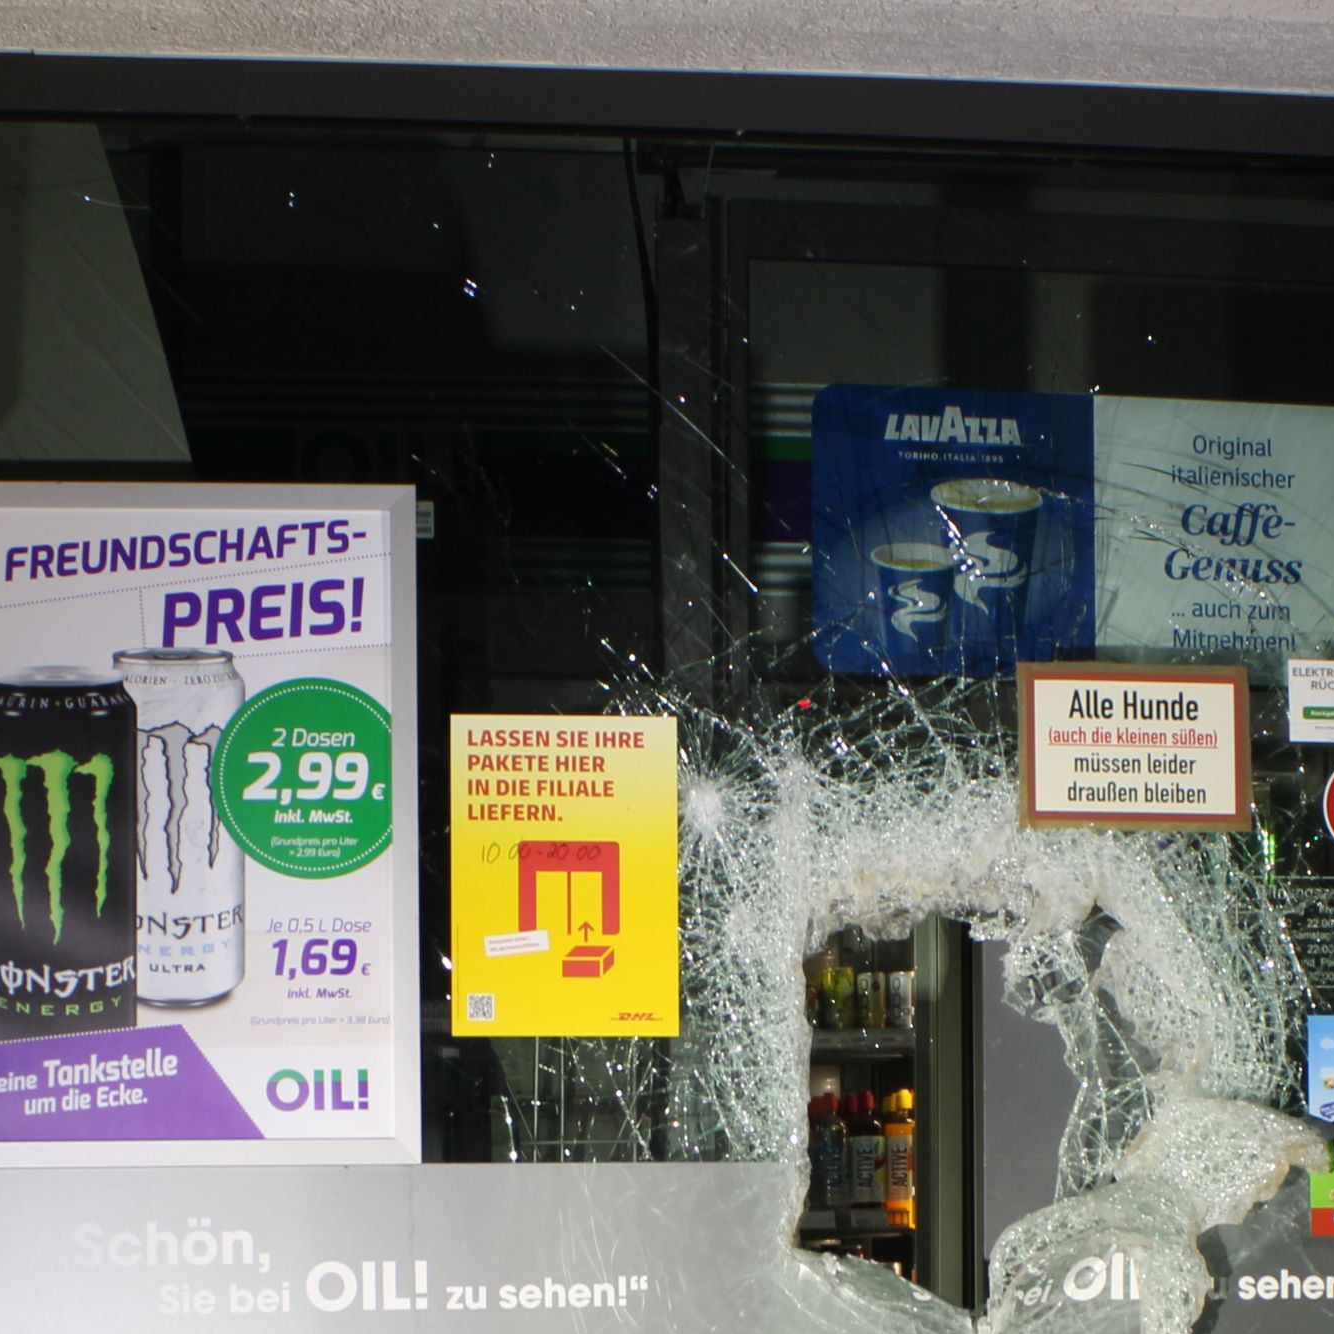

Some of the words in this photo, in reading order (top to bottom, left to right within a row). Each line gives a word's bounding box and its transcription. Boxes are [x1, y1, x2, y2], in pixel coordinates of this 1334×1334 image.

[884, 405, 1022, 446] LAVAZZA
[1192, 435, 1272, 460] Original
[1171, 464, 1295, 488] italienischer
[1181, 502, 1296, 546] Caffè-
[4, 520, 367, 582] FREUNDSCHAFTS-
[1164, 548, 1303, 584] Genuss
[162, 577, 365, 648] PREIS!
[1192, 601, 1241, 619] auch
[1247, 604, 1290, 621] zum
[1172, 628, 1296, 651] Mitnehmen!
[1068, 689, 1114, 719] Alle
[1123, 690, 1199, 721] Hunde
[271, 727, 287, 747] 2
[291, 727, 355, 747] Dosen
[467, 729, 550, 748] LASSEN
[556, 730, 589, 748] SIE
[595, 731, 645, 748] IHRE
[1048, 726, 1087, 745] (auch
[1091, 727, 1112, 744] die
[1117, 727, 1167, 745] kleinen
[1172, 728, 1218, 747] süßen)
[467, 754, 549, 772] PAKETE
[555, 755, 605, 773] HIER
[1074, 752, 1142, 774] müssen
[1148, 754, 1196, 775] leider
[242, 751, 369, 805] 2,99
[371, 783, 386, 800] €
[467, 779, 490, 796] IN
[496, 779, 530, 797] DIE
[536, 780, 615, 798] FILIALE
[1067, 781, 1138, 803] draußen
[1144, 783, 1207, 804] bleiben
[274, 809, 304, 823] inkl.
[308, 810, 353, 823] MwSt.
[467, 803, 563, 822] LIEFERN.
[266, 918, 283, 933] Je
[287, 918, 314, 934] 0,5
[318, 918, 327, 933] L
[332, 918, 372, 933] Dose
[149, 963, 206, 974] ULTRA
[272, 938, 357, 981] 1,69
[361, 963, 371, 976] €
[287, 987, 312, 999] inkl.
[315, 988, 352, 999] MwSt.
[43, 1047, 178, 1086] Tankstelle
[24, 1094, 57, 1116] um
[61, 1088, 91, 1113] die
[96, 1083, 148, 1109] Ecke.
[266, 1068, 369, 1112] OIL!
[892, 1146, 908, 1187] ACTIVE
[158, 1283, 216, 1315] Sie
[229, 1281, 291, 1313] bei
[306, 1260, 428, 1312] OIL!
[446, 1283, 487, 1310] zu
